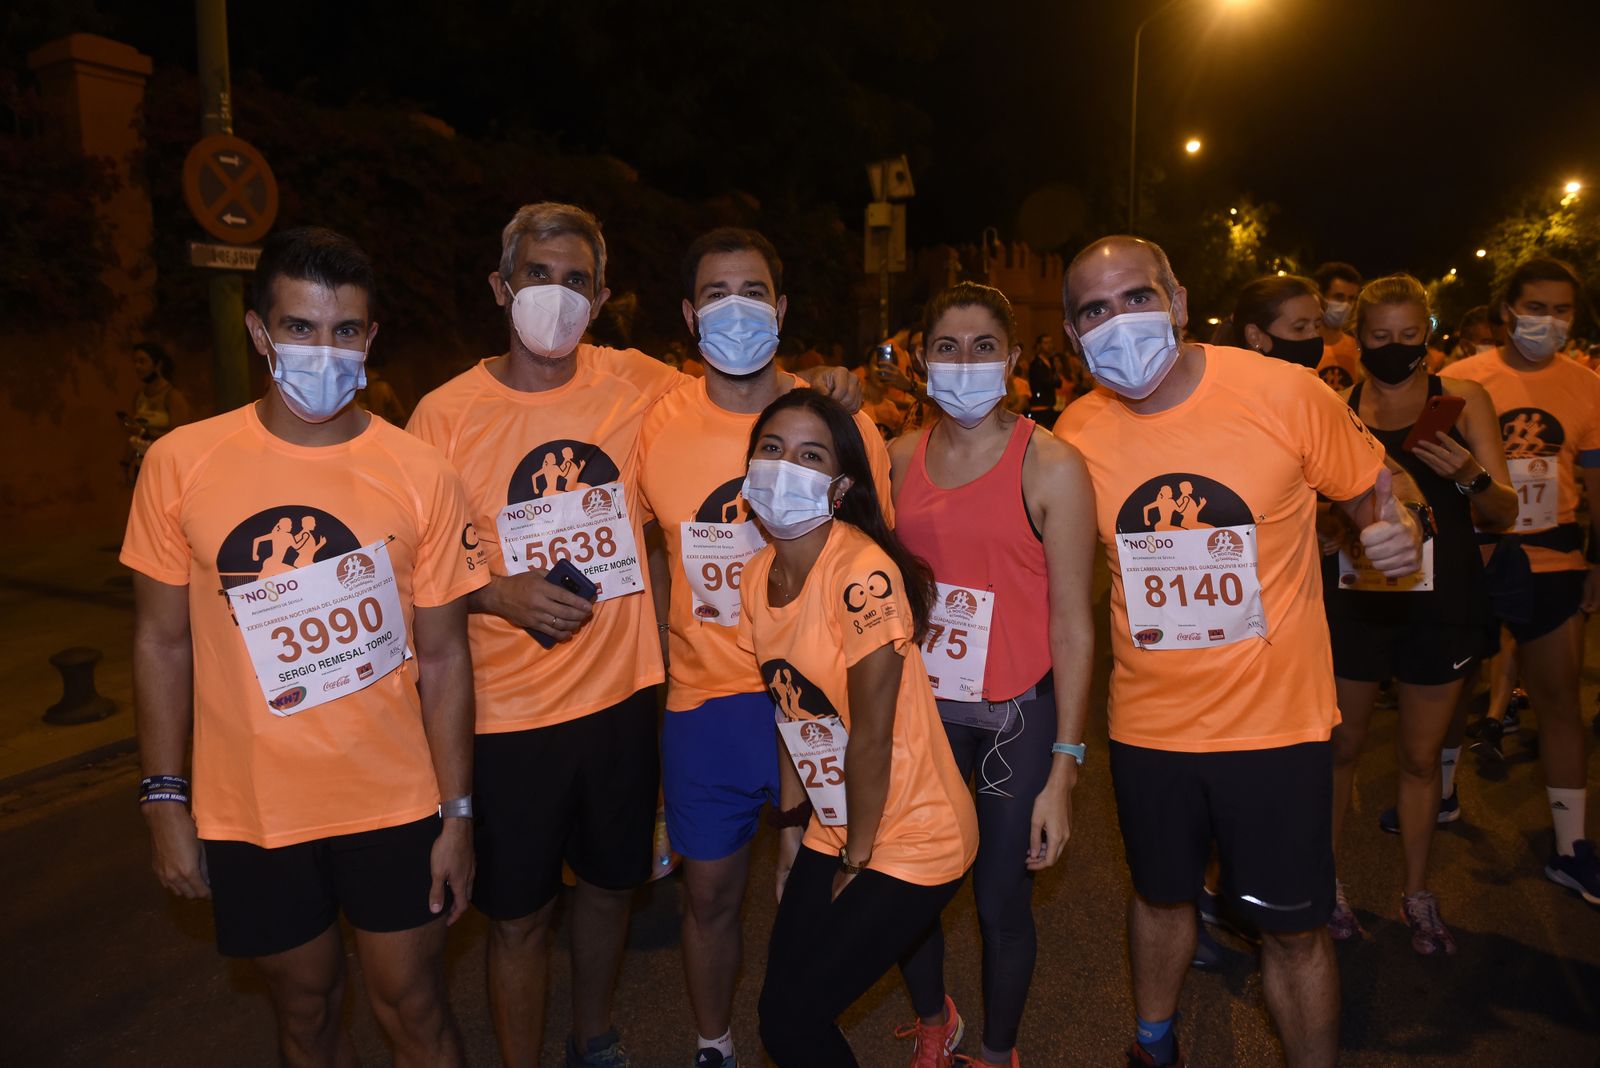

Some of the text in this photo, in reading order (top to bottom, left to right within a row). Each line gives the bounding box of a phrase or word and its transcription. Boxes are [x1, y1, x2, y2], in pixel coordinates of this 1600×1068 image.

[1517, 483, 1546, 504] 17
[525, 526, 617, 571] 5638
[584, 556, 637, 575] PÉREZ MORÓN
[702, 562, 744, 592] 96
[1144, 572, 1243, 608] 8140
[264, 615, 289, 627] CARRERA
[289, 604, 321, 619] NOCTURNA
[321, 600, 333, 609] DEL
[332, 586, 373, 605] GUADALQUIVIR
[271, 597, 383, 663] 3990
[926, 623, 968, 660] 75
[278, 663, 317, 682] SERGIO
[318, 647, 365, 670] REMESAL
[365, 631, 393, 651] TORNO
[275, 691, 300, 707] KH7
[798, 756, 846, 788] 25
